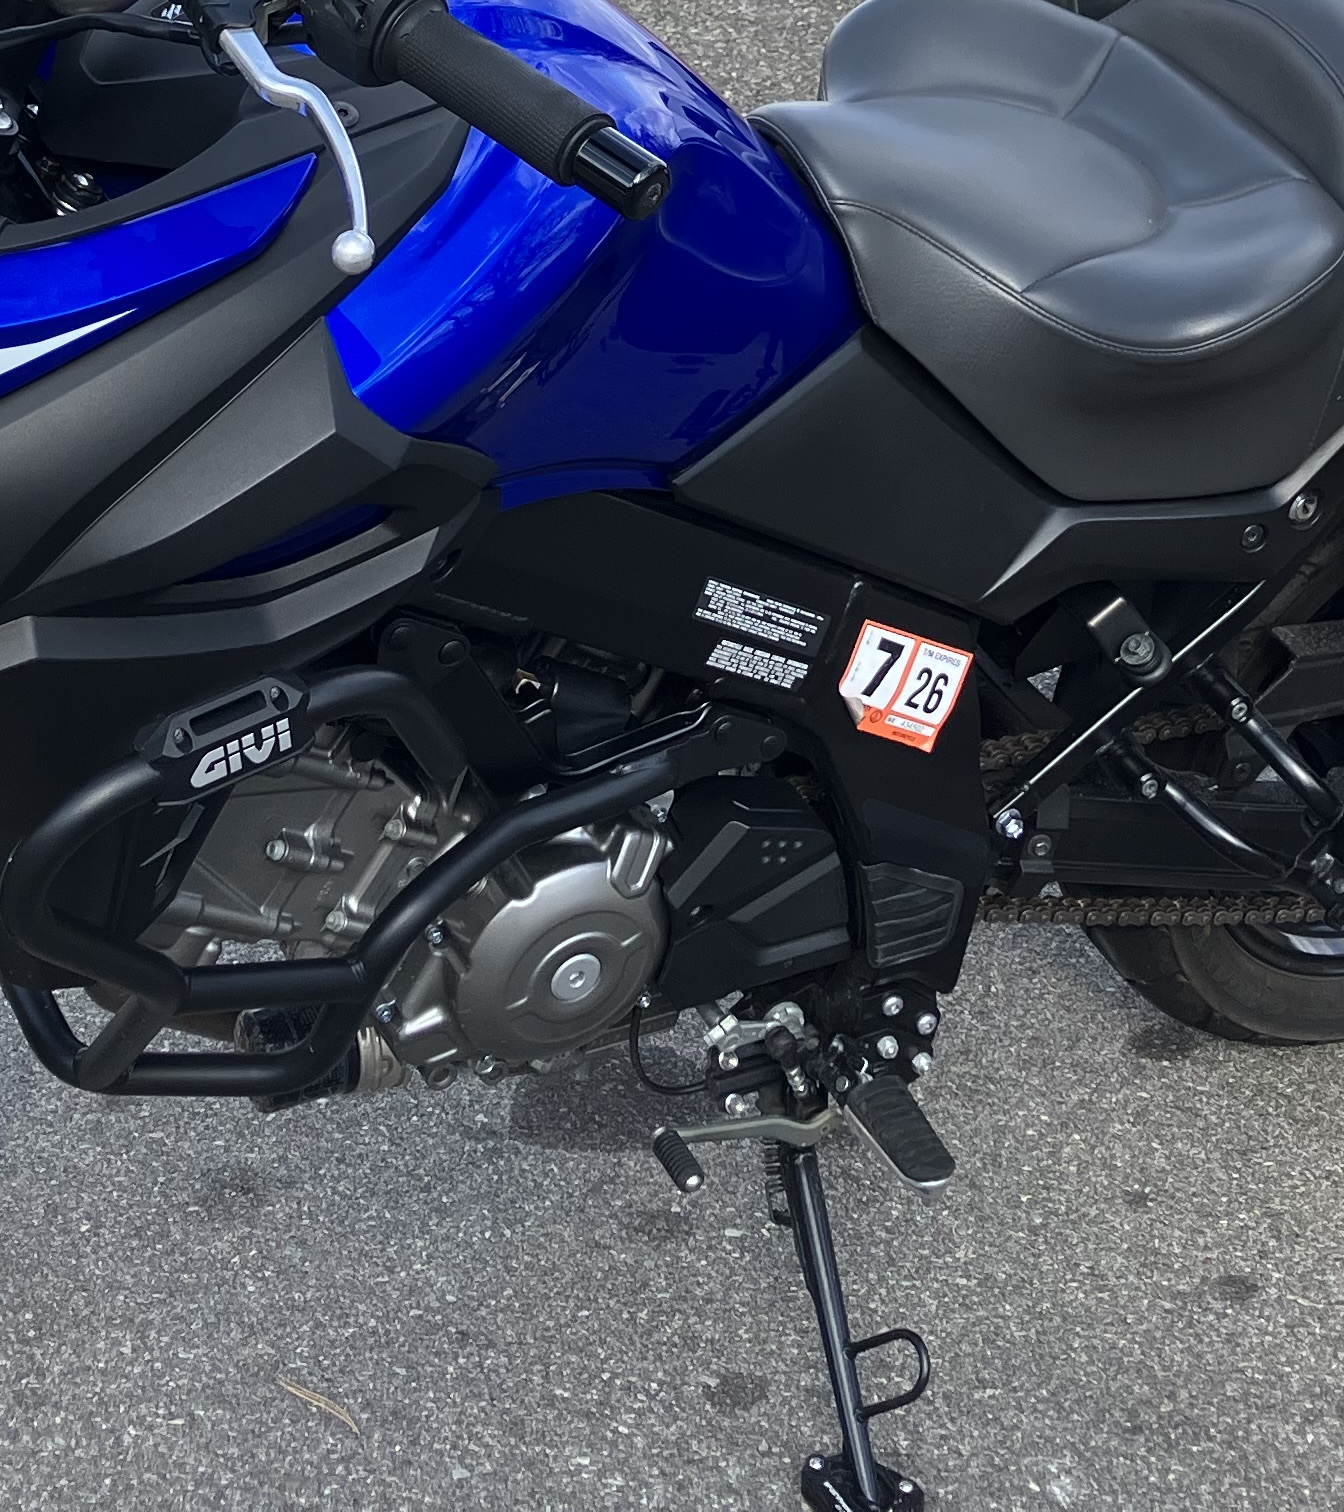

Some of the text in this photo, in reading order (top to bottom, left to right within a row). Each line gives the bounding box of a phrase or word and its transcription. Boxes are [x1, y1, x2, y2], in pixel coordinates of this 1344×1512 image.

[861, 636, 906, 698] 7
[904, 666, 949, 715] 26
[190, 717, 293, 788] GIVI
